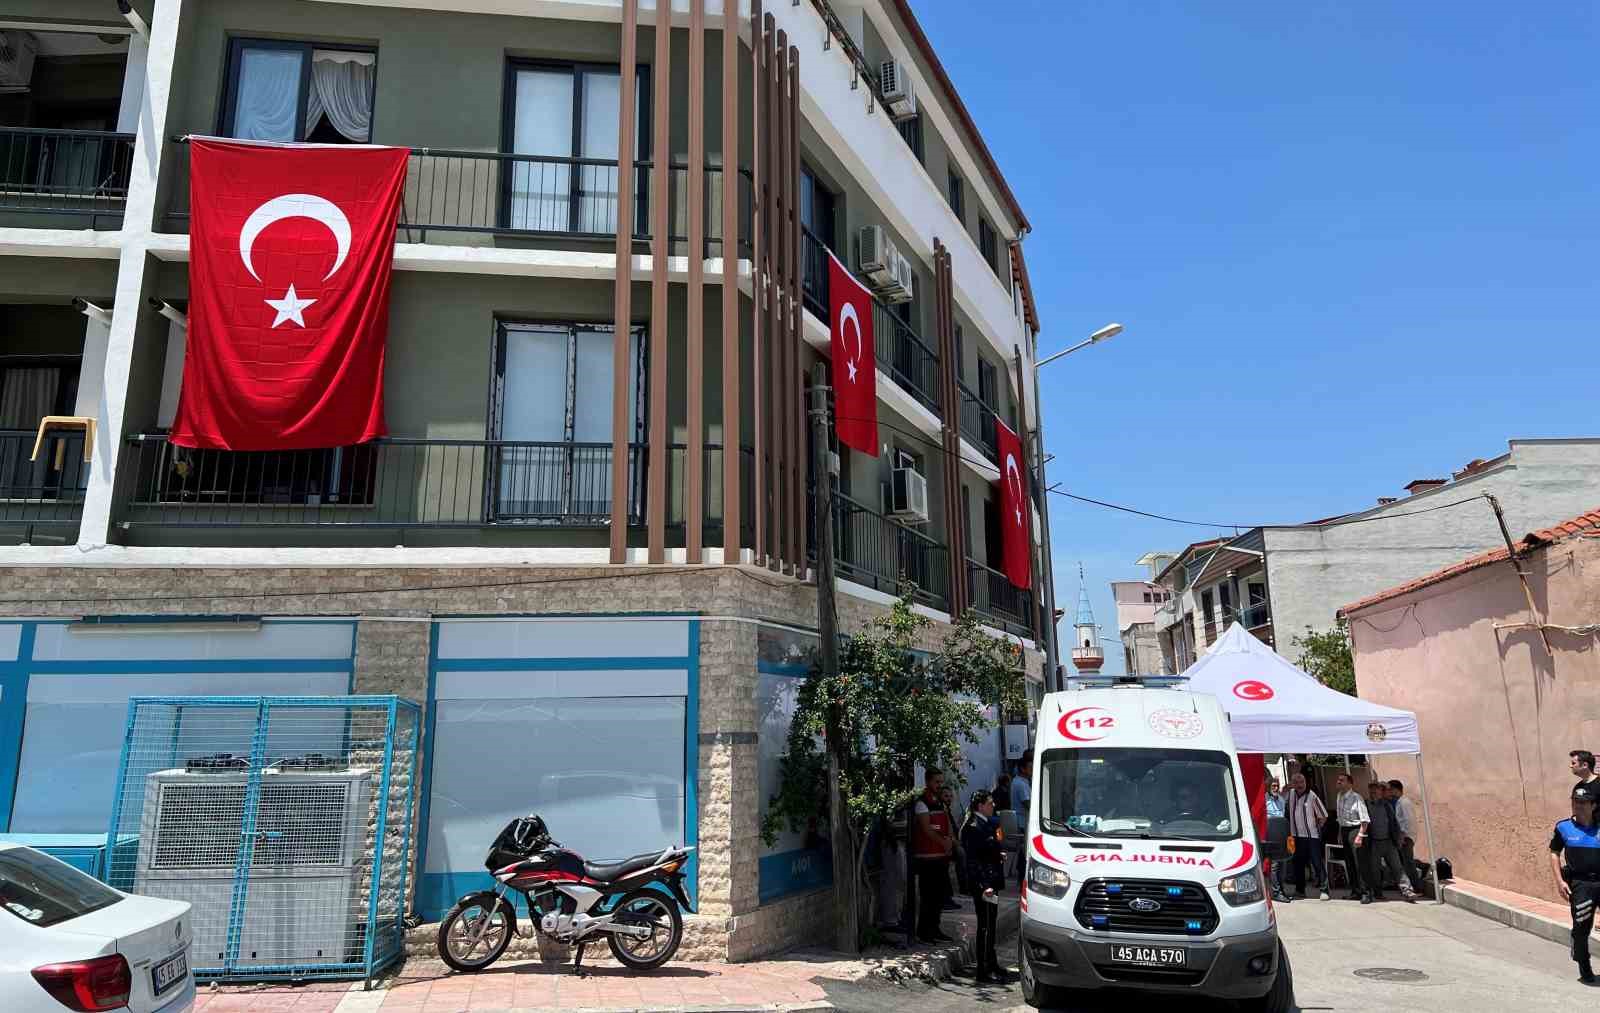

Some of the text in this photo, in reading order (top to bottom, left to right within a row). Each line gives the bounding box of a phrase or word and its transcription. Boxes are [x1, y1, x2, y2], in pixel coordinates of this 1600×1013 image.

[1070, 717, 1114, 729] 112
[1118, 946, 1183, 964] 45 ACA 570
